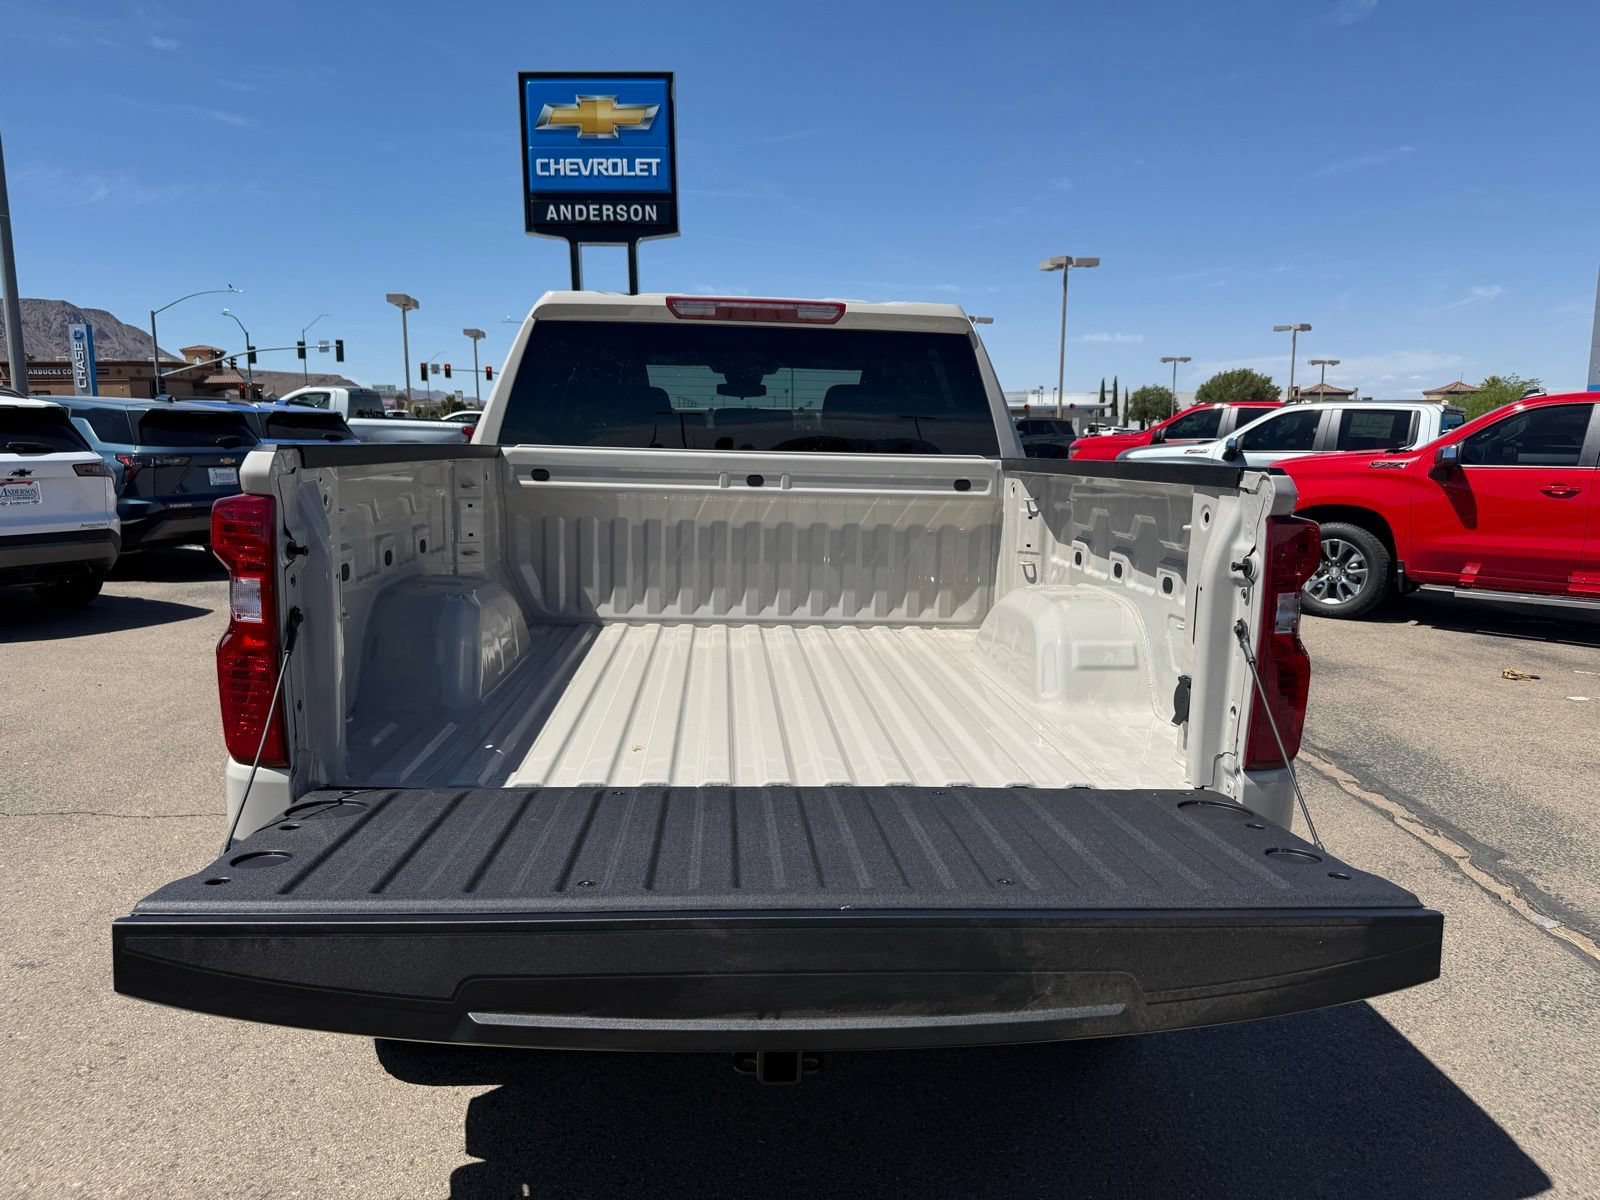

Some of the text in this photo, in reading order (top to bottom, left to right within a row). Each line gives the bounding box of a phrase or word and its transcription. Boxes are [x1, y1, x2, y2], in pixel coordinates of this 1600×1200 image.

[536, 158, 661, 177] CHEVROLET
[546, 204, 658, 221] ANDERSON
[73, 342, 87, 388] CHASE
[0, 487, 37, 497] ANDERSON
